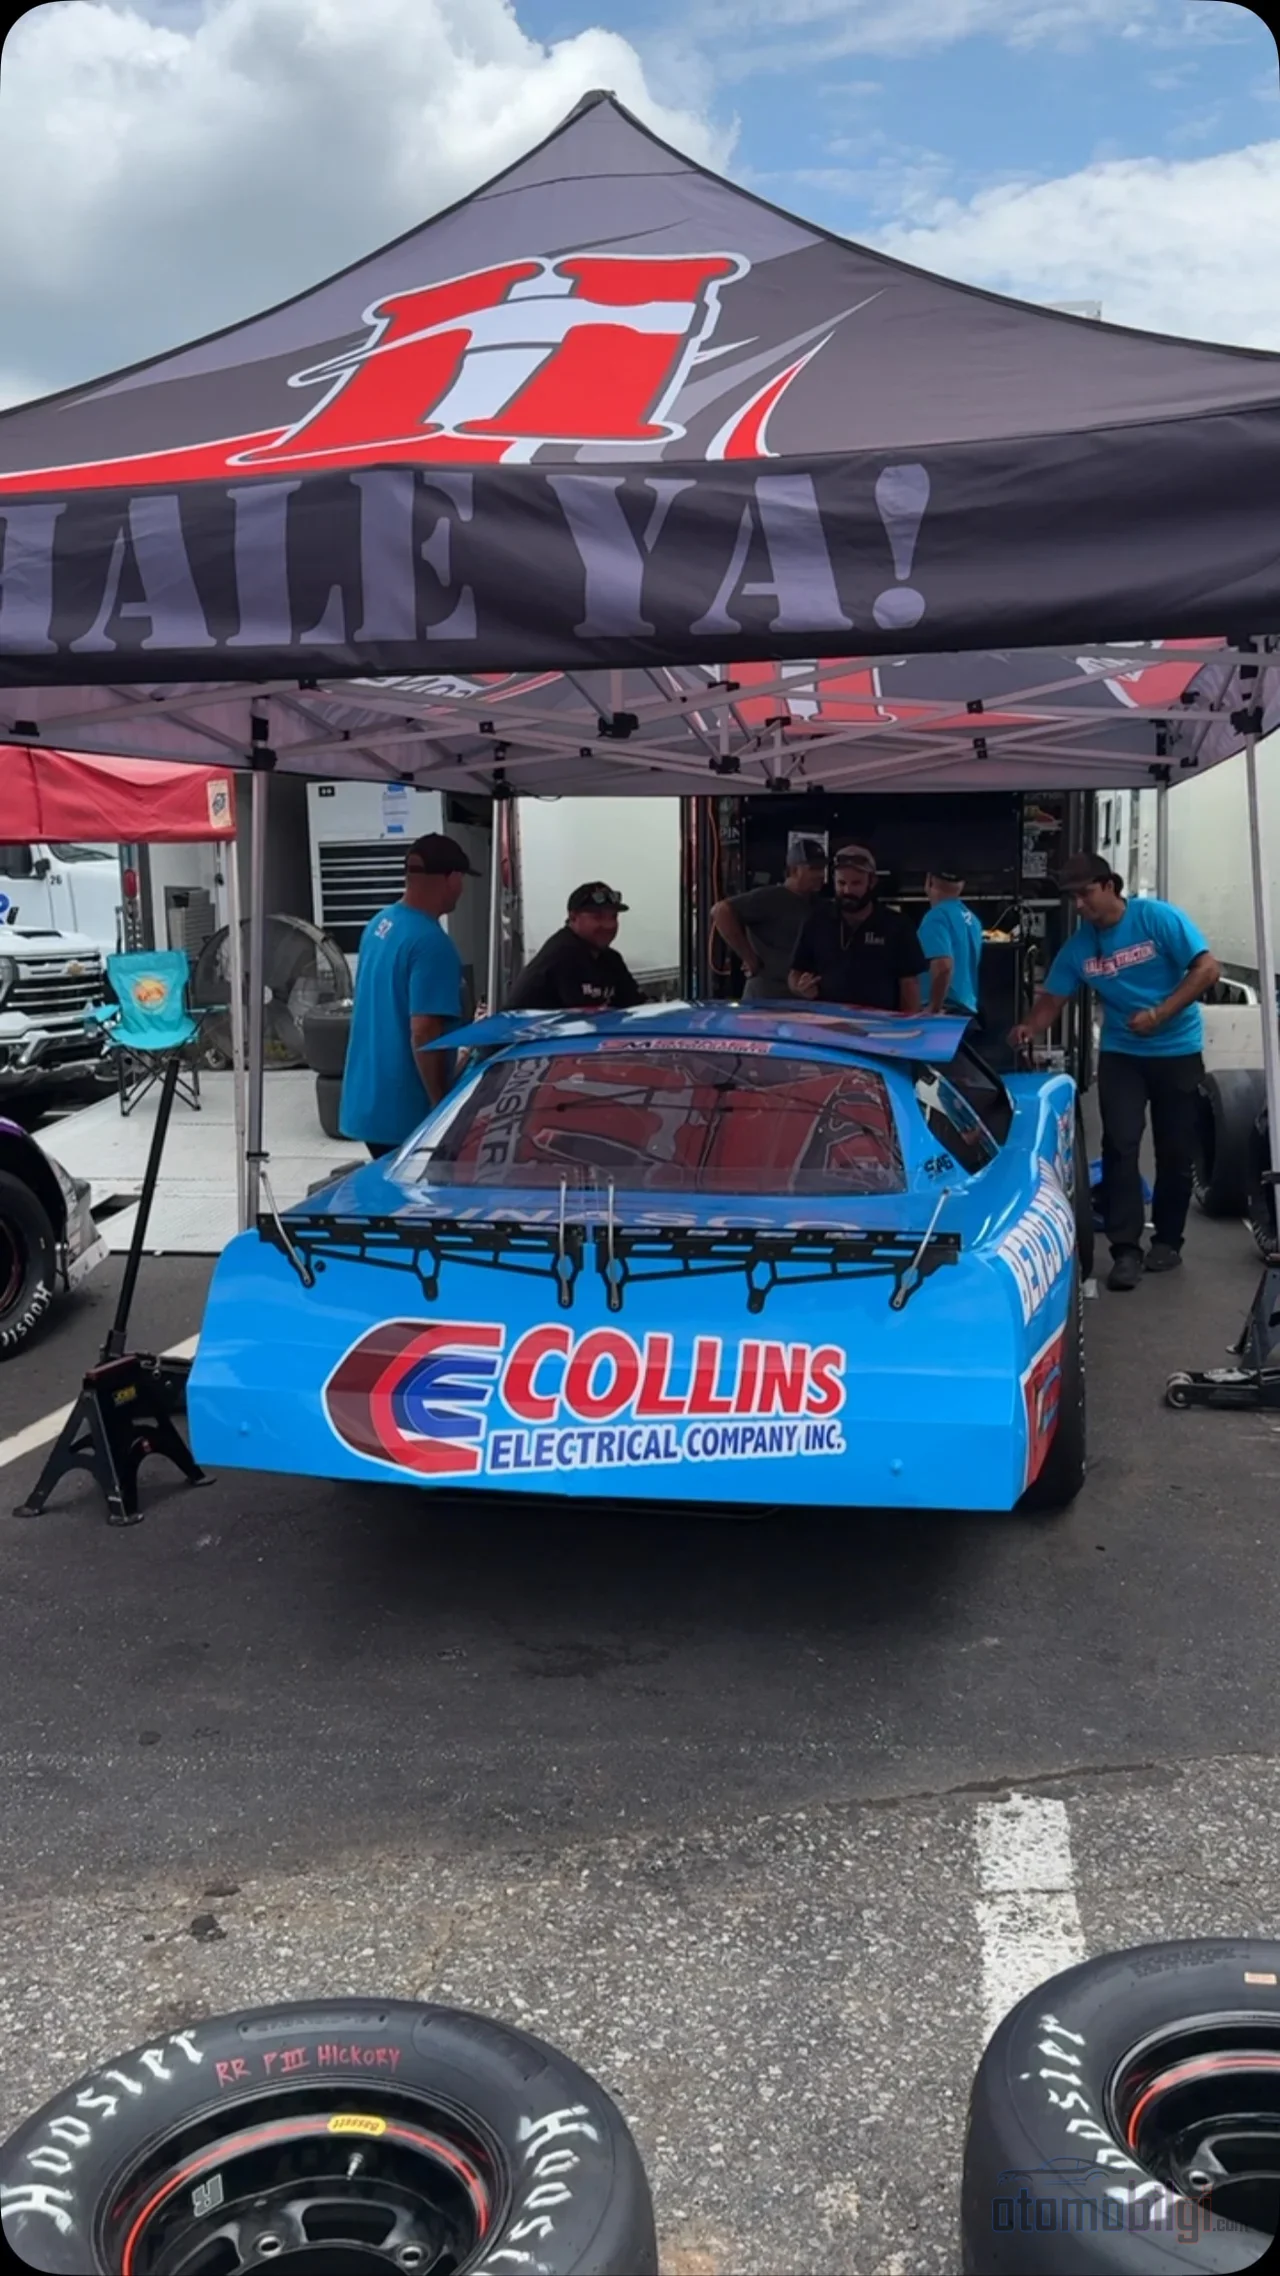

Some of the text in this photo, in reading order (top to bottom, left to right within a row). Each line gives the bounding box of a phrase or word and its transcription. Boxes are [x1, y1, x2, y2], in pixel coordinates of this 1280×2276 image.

[545, 463, 931, 639] YA!
[50, 875, 62, 885] 26
[502, 1325, 844, 1421] COLLINS
[489, 1423, 843, 1470] ELECTRICAL COMPANY INC.
[215, 2057, 252, 2088] RR
[317, 2044, 402, 2074] HICKORY
